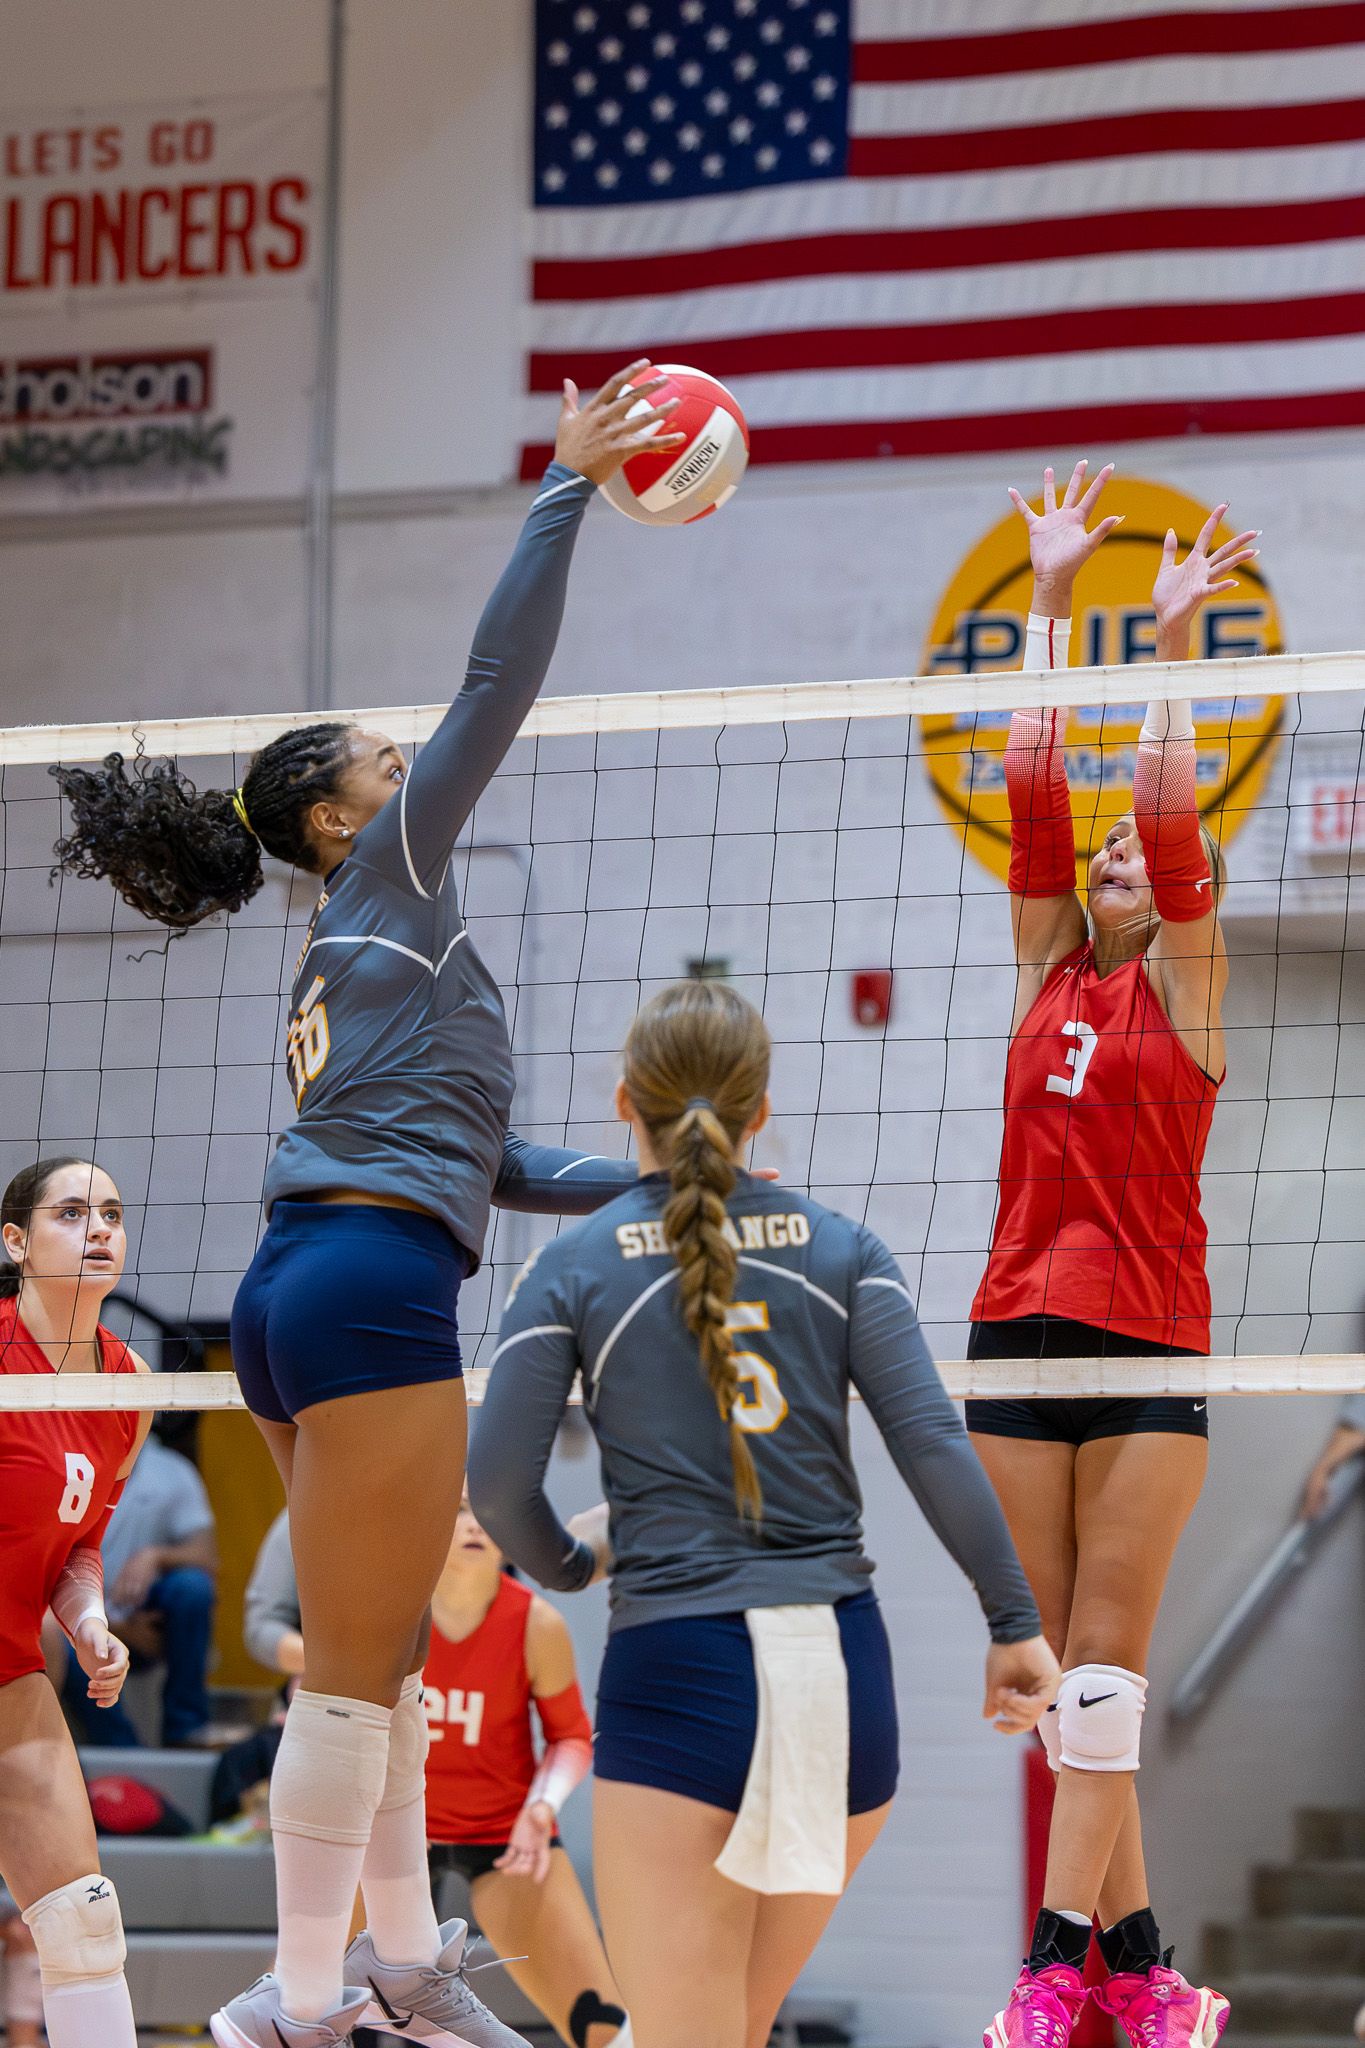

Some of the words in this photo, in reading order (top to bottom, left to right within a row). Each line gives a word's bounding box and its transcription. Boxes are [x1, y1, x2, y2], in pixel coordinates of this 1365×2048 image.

[5, 126, 121, 178] LETS
[149, 119, 216, 168] GO
[4, 175, 310, 289] LANCERS
[0, 352, 205, 414] holson
[670, 441, 720, 491] TACHIKARA
[1045, 1020, 1098, 1098] 3
[616, 1213, 812, 1260] SHANGO
[722, 1300, 789, 1434] 5
[57, 1451, 96, 1524] 8
